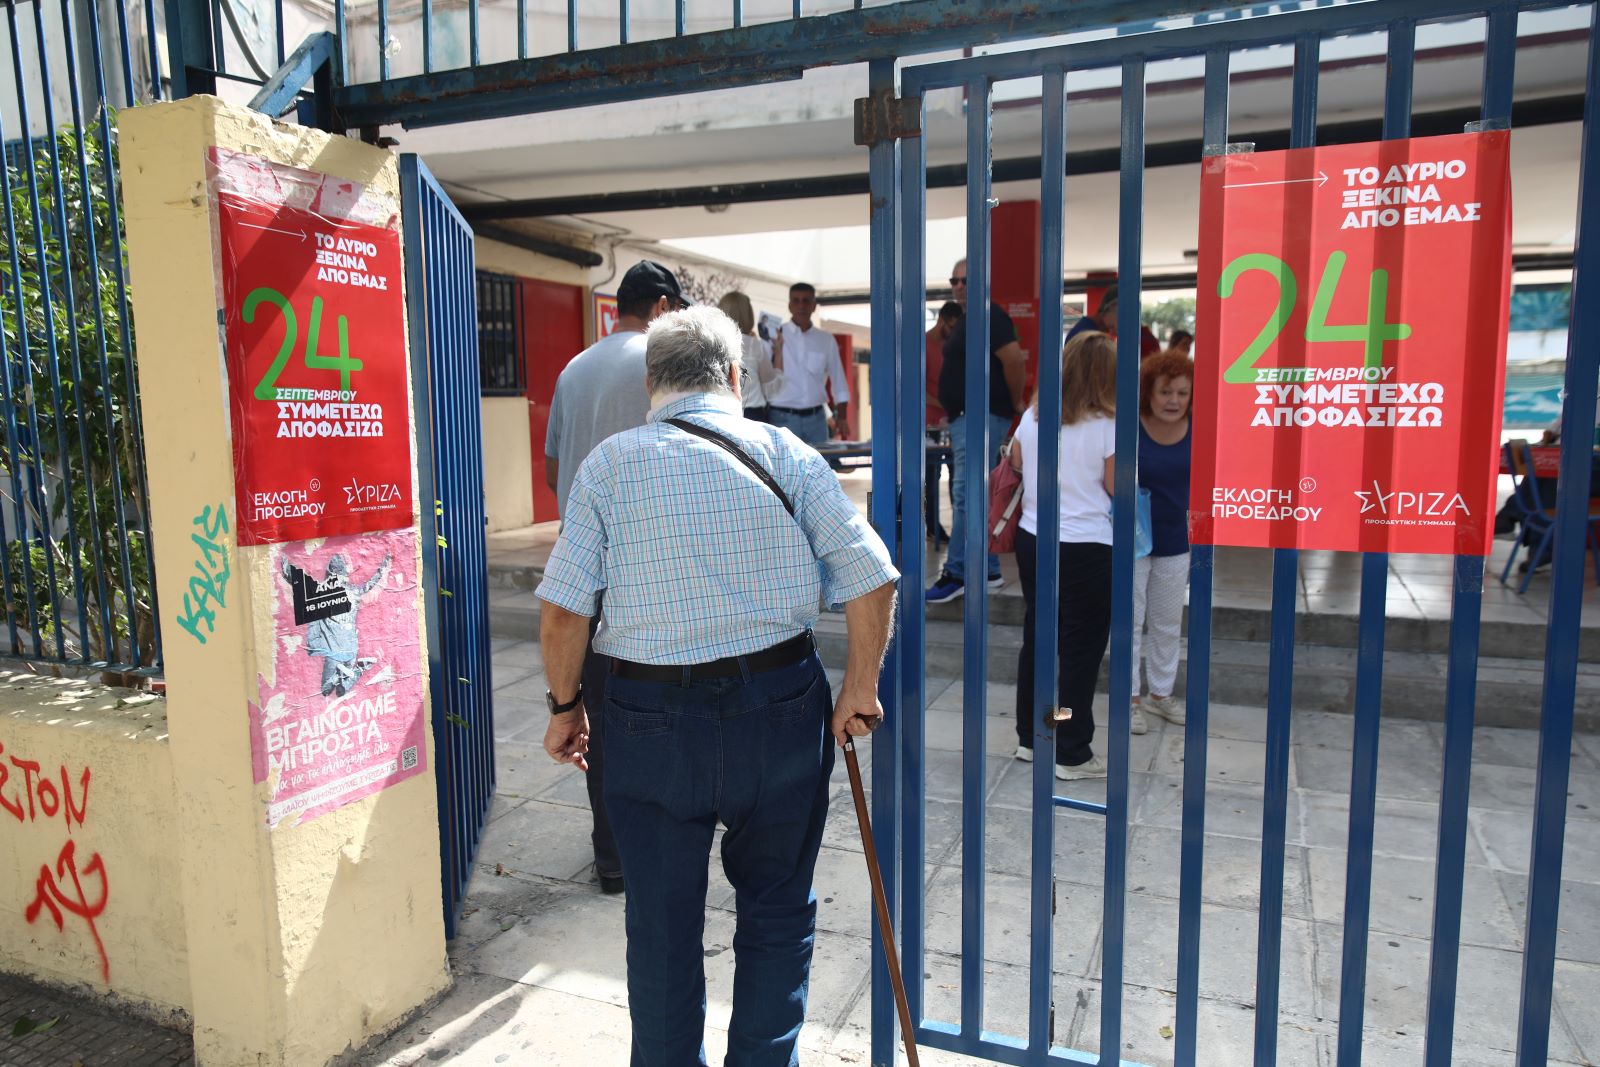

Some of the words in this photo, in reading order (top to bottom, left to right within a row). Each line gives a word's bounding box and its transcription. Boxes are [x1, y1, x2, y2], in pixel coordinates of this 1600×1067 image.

[1343, 166, 1380, 186] ΤΟ
[1383, 159, 1467, 184] ΑΥΡΙΟ
[1341, 184, 1441, 209] ΞΕΚΙΝΑ
[1340, 208, 1400, 230] ΑΠΟ
[1403, 202, 1482, 226] ΕΜΑΣ
[314, 232, 335, 249] ΤΟ
[336, 237, 377, 257] ΑΥΡΙΟ
[315, 249, 368, 272] ΞΕΚΙΝΑ
[317, 267, 349, 285] ΑΠΟ
[350, 272, 388, 291] ΕΜΑΣ
[1217, 250, 1412, 384] 24
[242, 287, 363, 403] 24
[1254, 366, 1395, 383] ΣΕΠΤΕΜΒΡΙΟΥ
[275, 388, 357, 401] ΣΕΠΤΕΜΒΡΙΟΥ
[1254, 382, 1444, 405] ΣΥΜΜΕΤΕΧΩ
[276, 402, 383, 420] ΣΥΜΜΕΤΕΧΩ
[1250, 406, 1443, 428] ΑΠΟΦΑΣΙΖΩ
[276, 420, 384, 439] ΑΠΟΦΑΣΙΖΩ
[254, 490, 307, 506] ΕΚΛΟΓΗ
[342, 477, 402, 505] ΣΥΡΙΖΑ
[1212, 487, 1292, 504] ΕΚΛΟΓΗ
[1353, 480, 1471, 516] ΣΥΡΙΖΑ
[255, 503, 326, 520] ΠΡΟΕΔΡΟΥ
[1211, 504, 1323, 522] ΠΡΟΕΔΡΟΥ
[306, 603, 316, 612] 16
[266, 691, 397, 753] ΒΓΑΙΝΟΥΜΕ
[267, 720, 382, 772] ΜΠΡΟΣΤΑ
